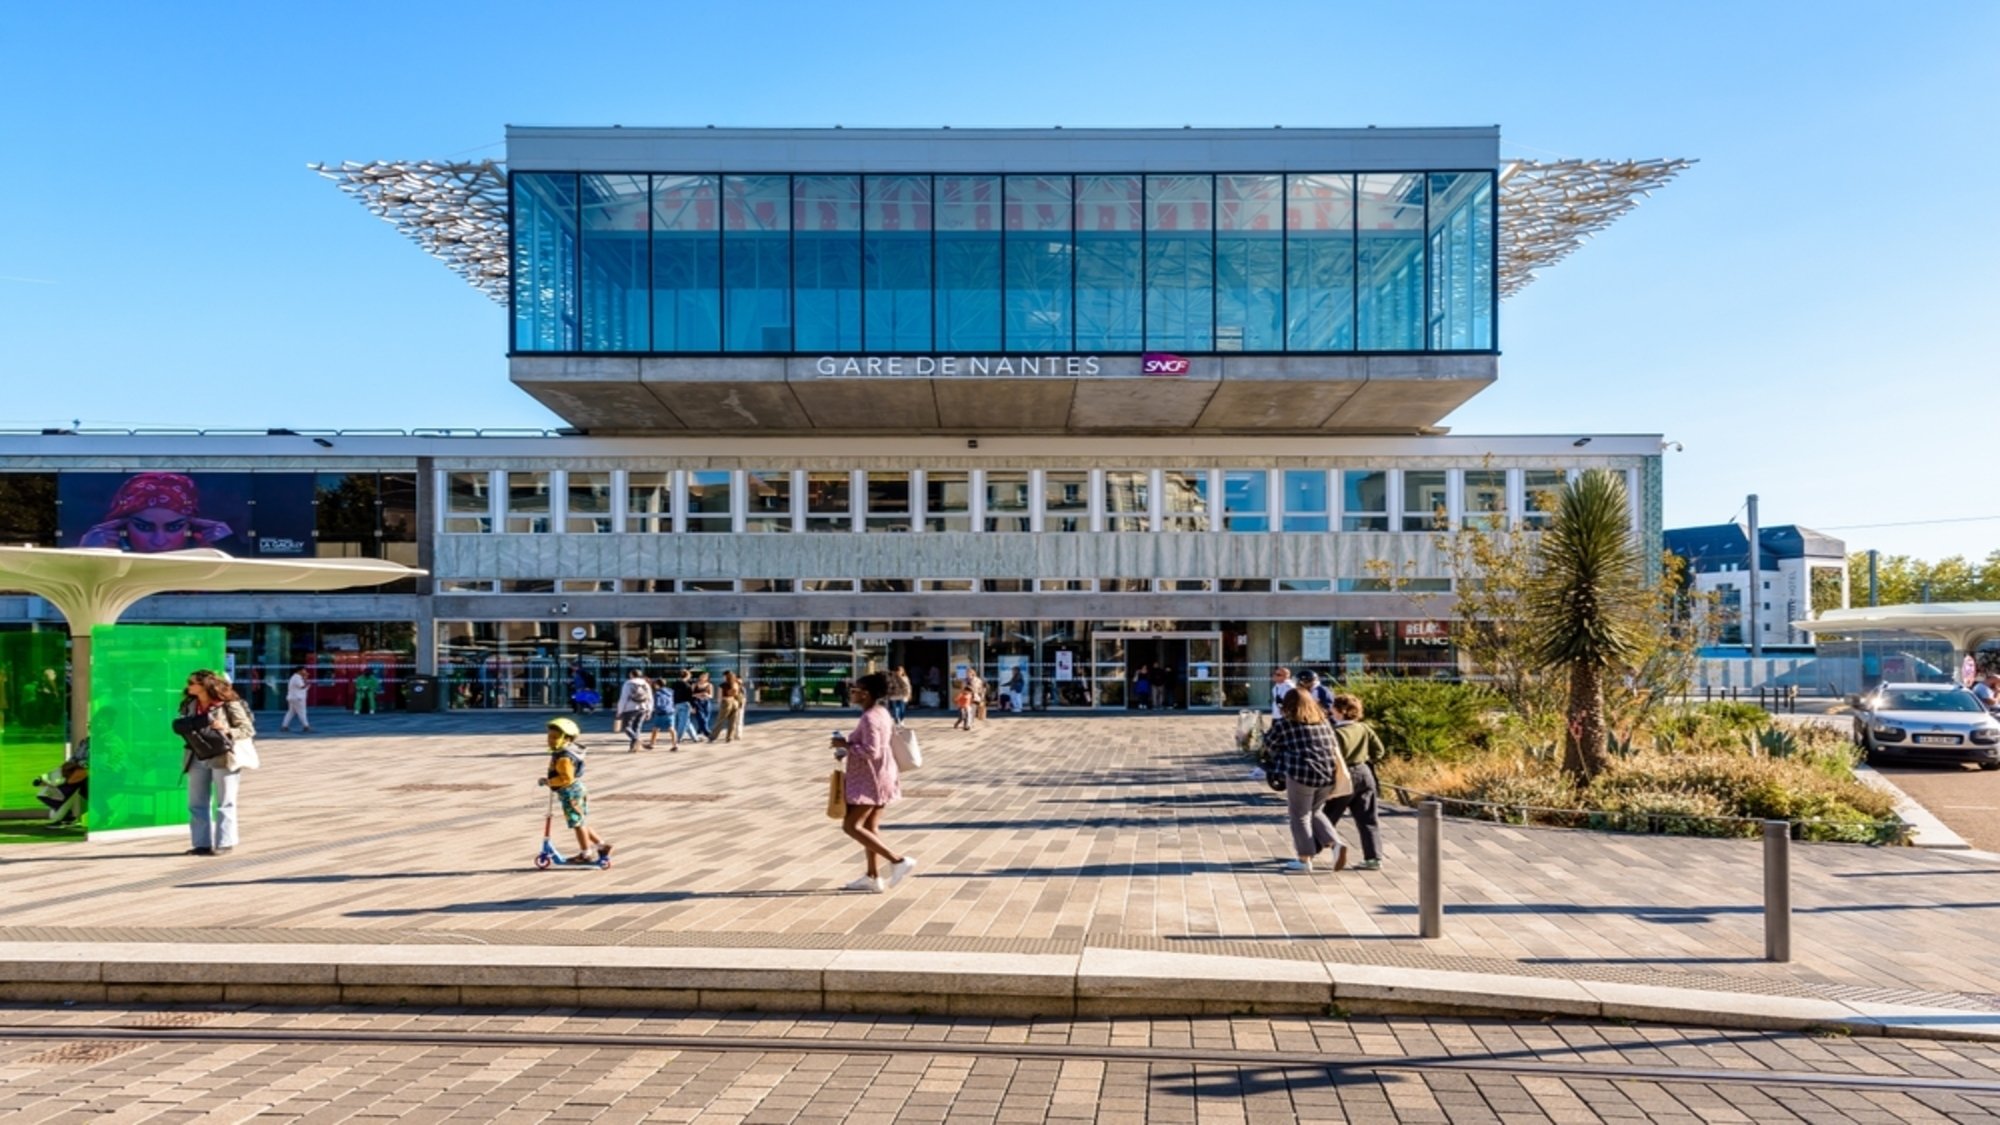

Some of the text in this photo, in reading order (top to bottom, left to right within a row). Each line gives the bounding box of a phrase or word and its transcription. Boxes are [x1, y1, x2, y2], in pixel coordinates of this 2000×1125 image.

[816, 356, 1100, 375] GARE DE NANTES
[1144, 360, 1188, 373] SNCF
